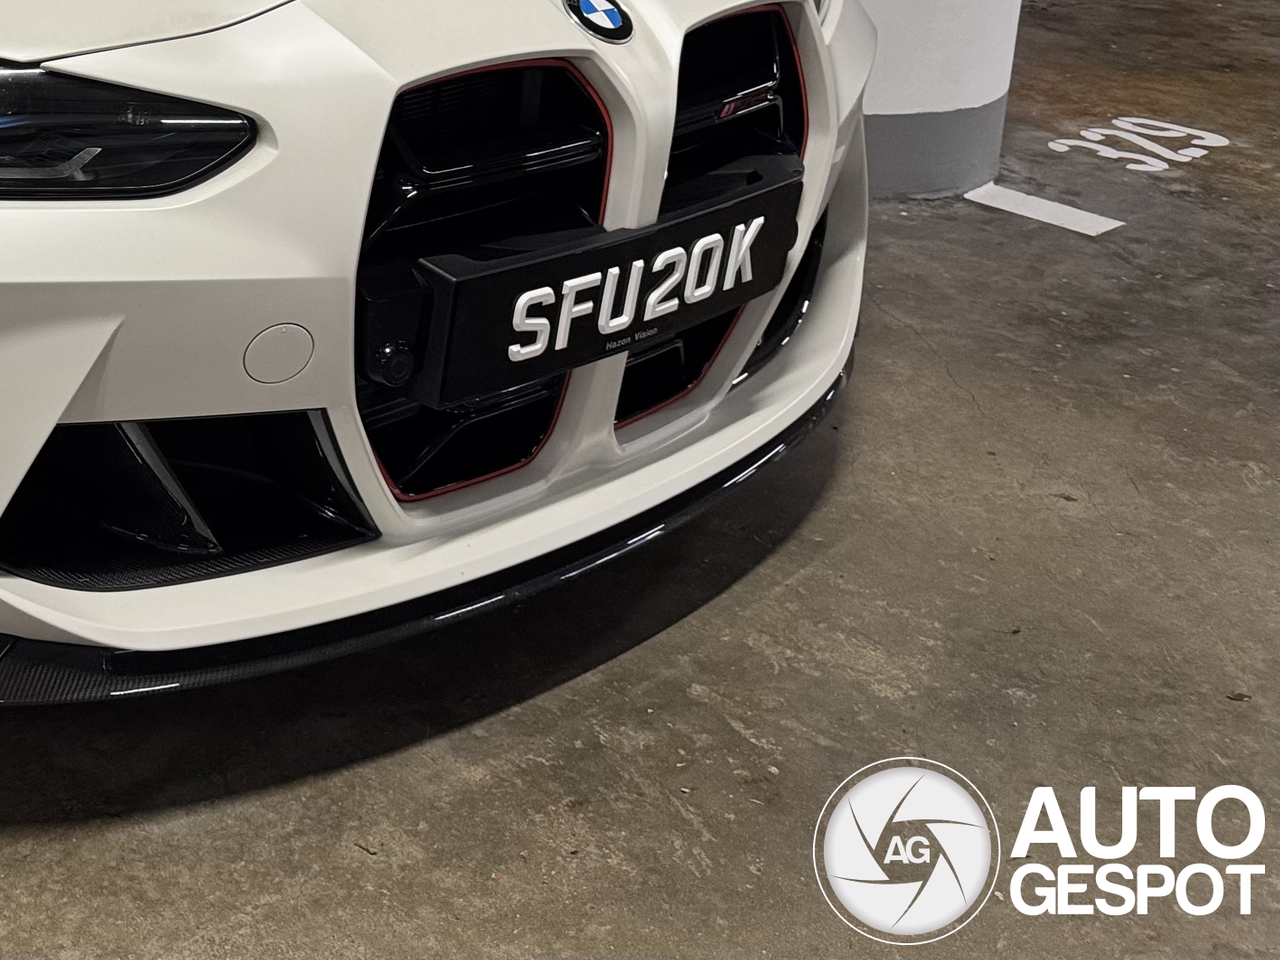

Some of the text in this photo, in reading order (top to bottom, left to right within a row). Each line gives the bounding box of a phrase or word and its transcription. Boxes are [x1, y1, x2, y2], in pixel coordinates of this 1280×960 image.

[507, 215, 766, 363] SFU20K
[605, 327, 658, 351] Hazon Vision
